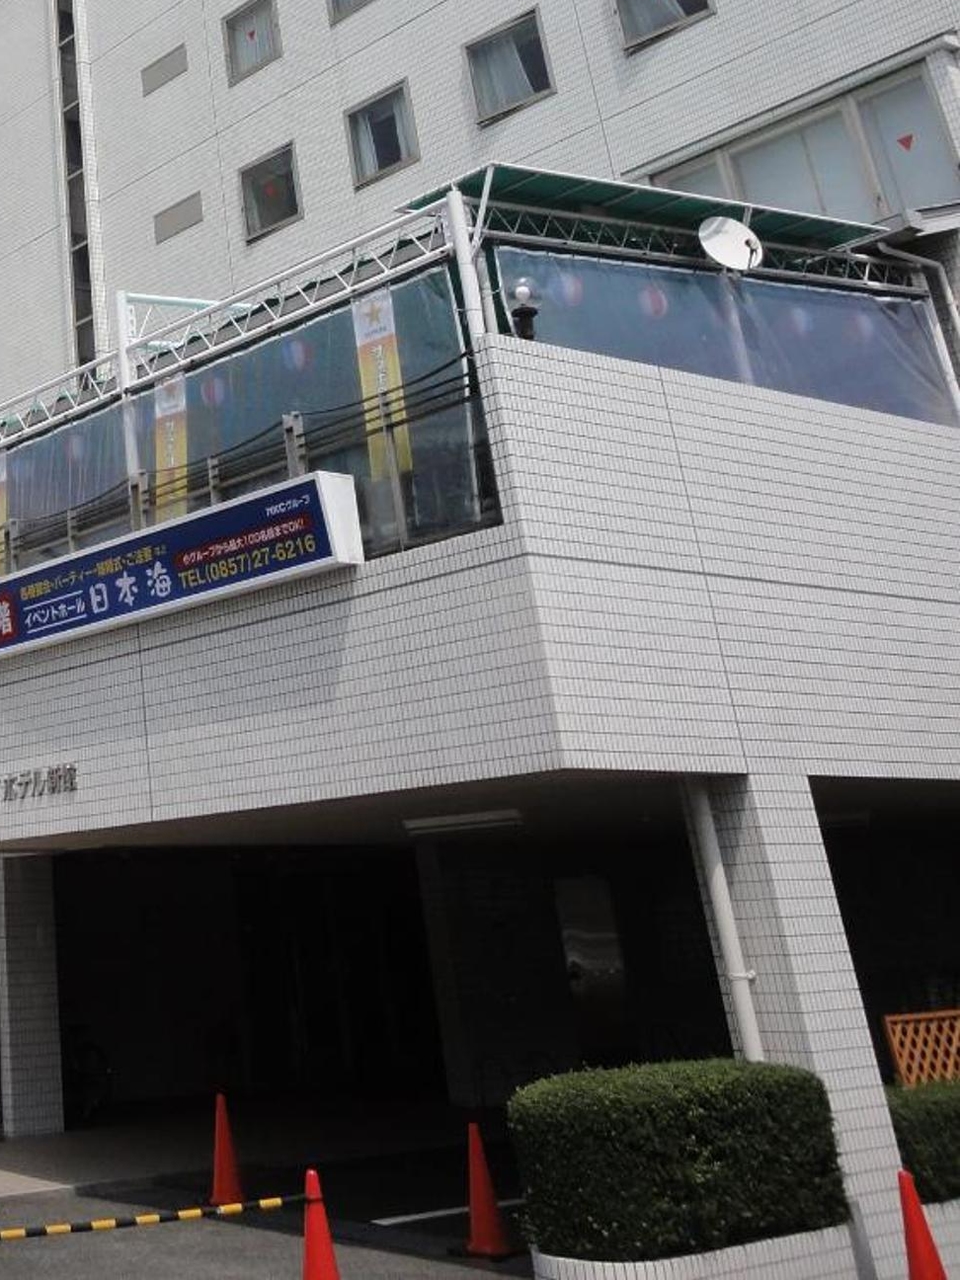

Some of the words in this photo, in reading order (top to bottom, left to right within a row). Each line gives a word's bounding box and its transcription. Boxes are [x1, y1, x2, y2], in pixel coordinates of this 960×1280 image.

[24, 598, 86, 630] イベントホール
